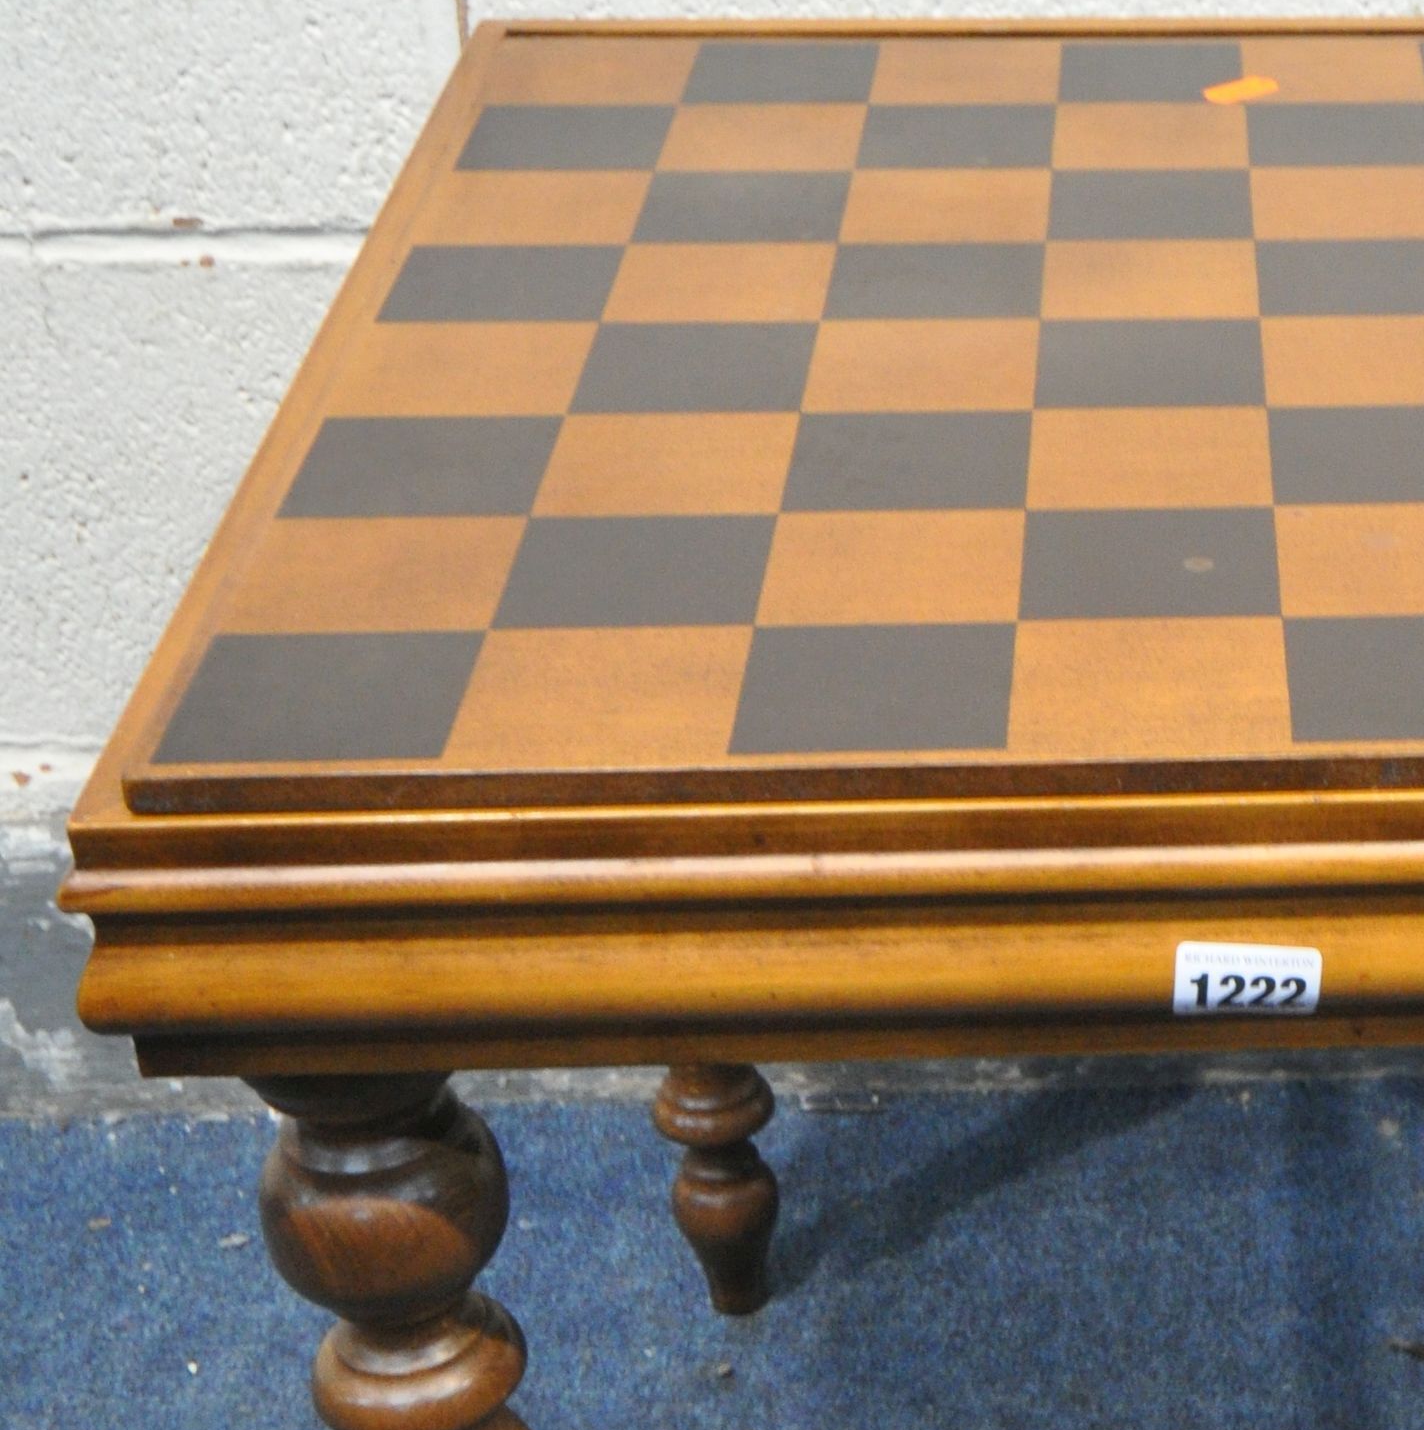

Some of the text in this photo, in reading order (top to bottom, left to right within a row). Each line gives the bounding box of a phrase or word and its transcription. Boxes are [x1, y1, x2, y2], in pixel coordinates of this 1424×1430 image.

[1185, 952, 1314, 968] RICHARD WINTERTON
[1190, 973, 1307, 1007] 1222
